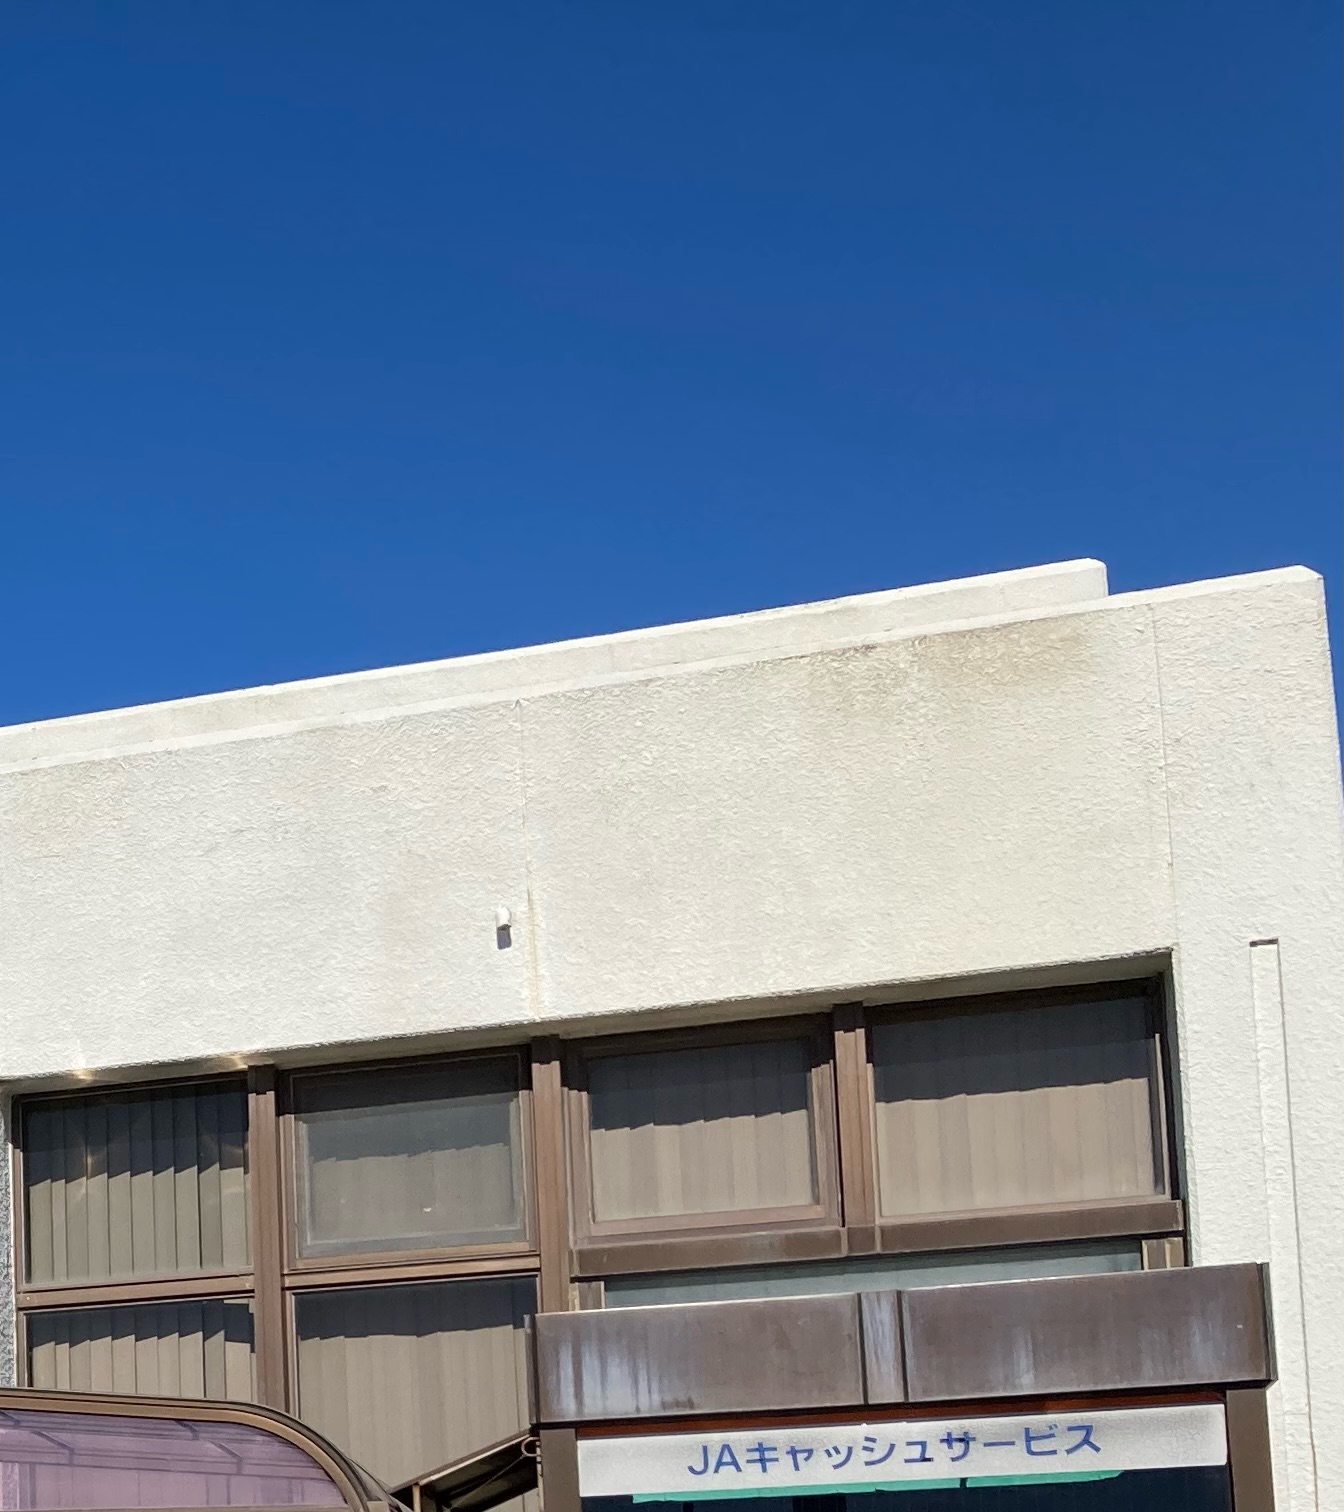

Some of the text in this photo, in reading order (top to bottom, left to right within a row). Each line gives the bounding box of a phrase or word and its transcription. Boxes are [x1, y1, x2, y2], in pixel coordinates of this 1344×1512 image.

[687, 1425, 1102, 1475] JAキャッシュサービス
